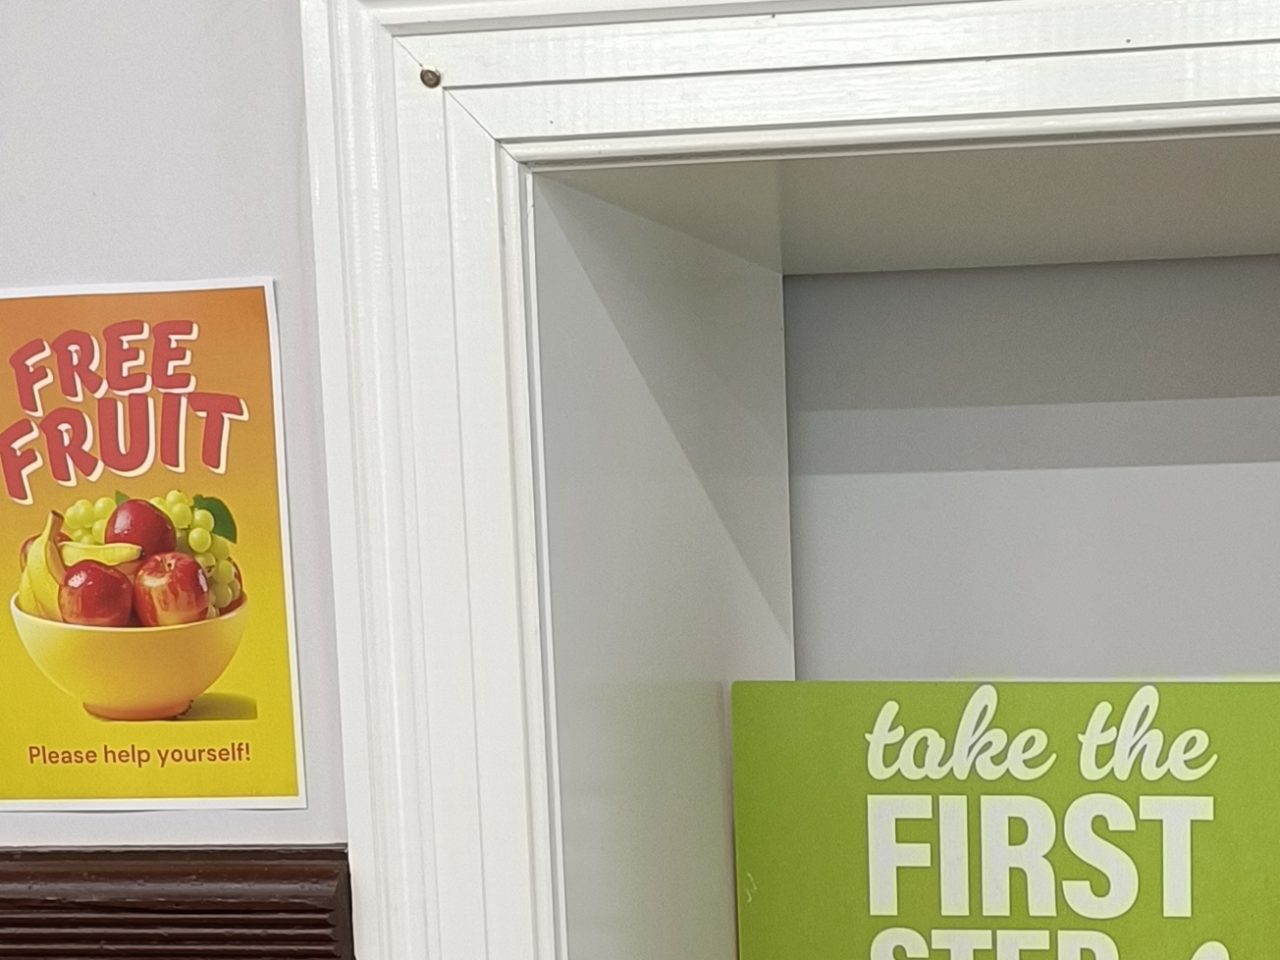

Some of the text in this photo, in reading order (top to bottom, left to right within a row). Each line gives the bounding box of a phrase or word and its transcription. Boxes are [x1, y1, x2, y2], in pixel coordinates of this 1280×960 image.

[9, 320, 198, 417] FREE
[0, 392, 248, 505] FRUIT
[28, 742, 250, 768] Please help yourself!
[865, 683, 1219, 782] take the
[866, 793, 1215, 920] FIRST
